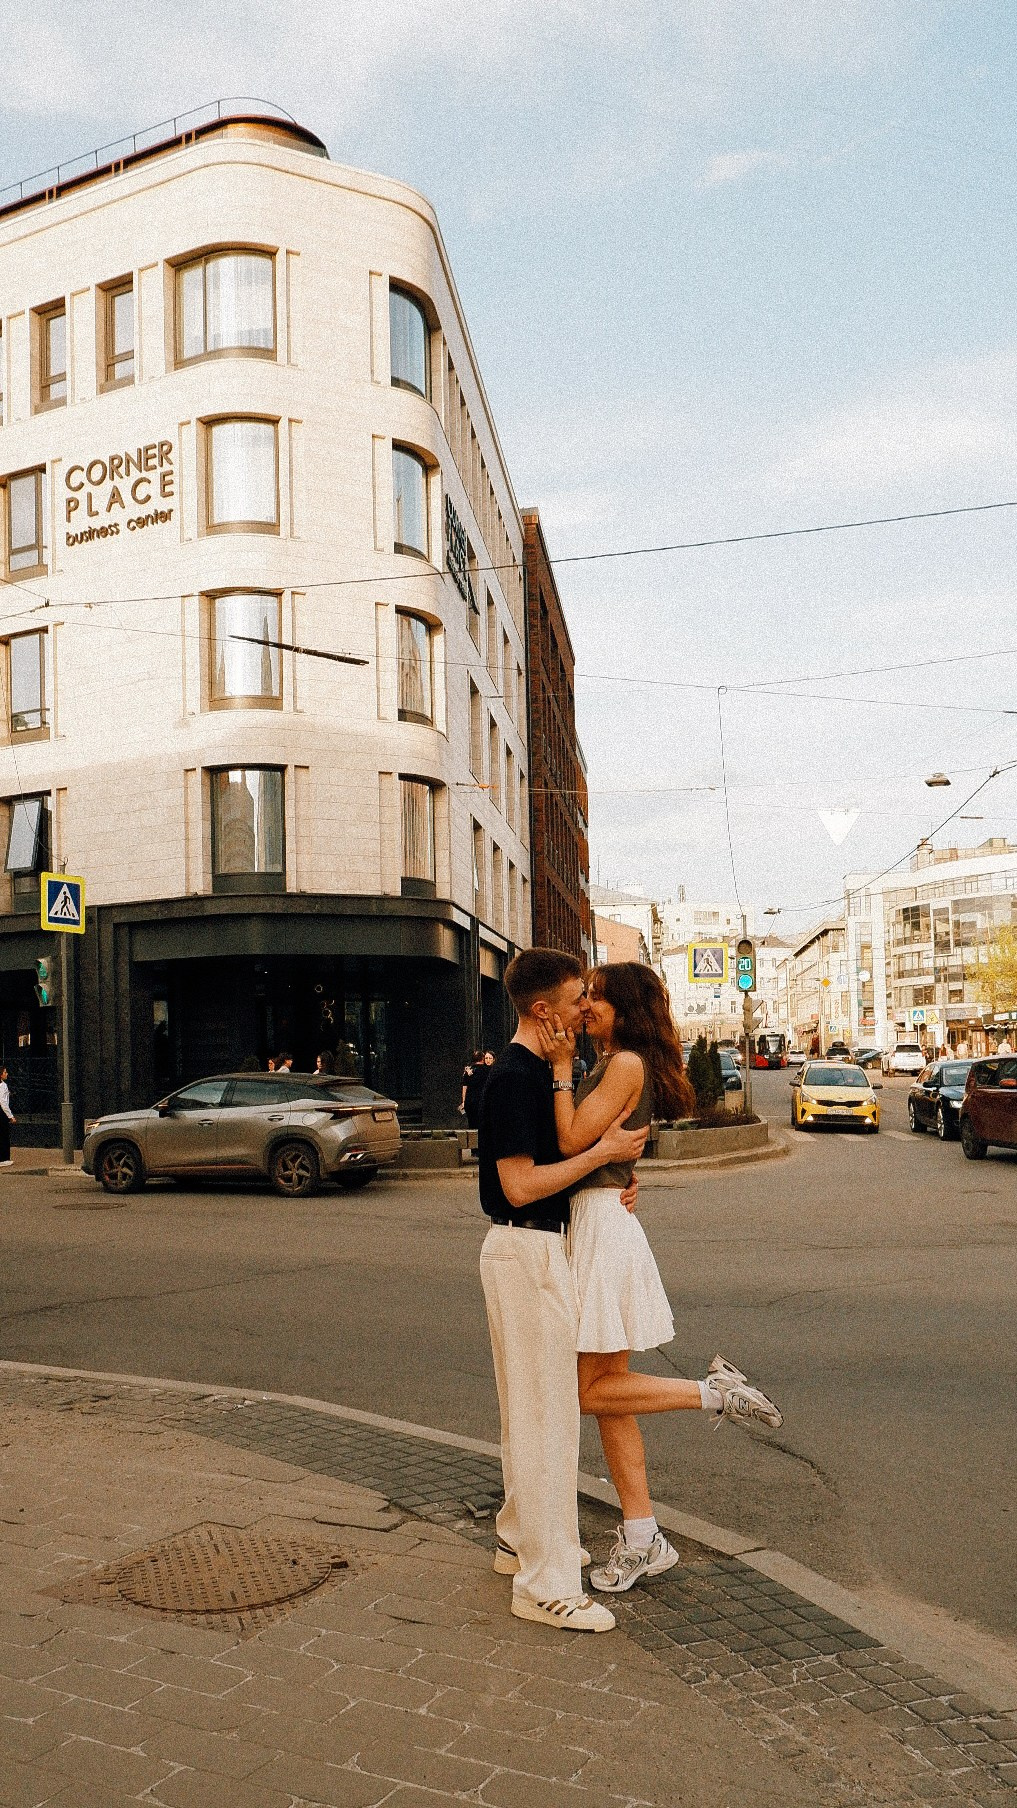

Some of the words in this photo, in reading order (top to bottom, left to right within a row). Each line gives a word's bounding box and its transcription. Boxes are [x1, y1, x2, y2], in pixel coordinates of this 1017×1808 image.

[65, 440, 173, 492] CORNER
[66, 470, 174, 523] PLACE
[66, 522, 120, 547] business
[127, 508, 174, 531] center
[738, 958, 752, 970] 20
